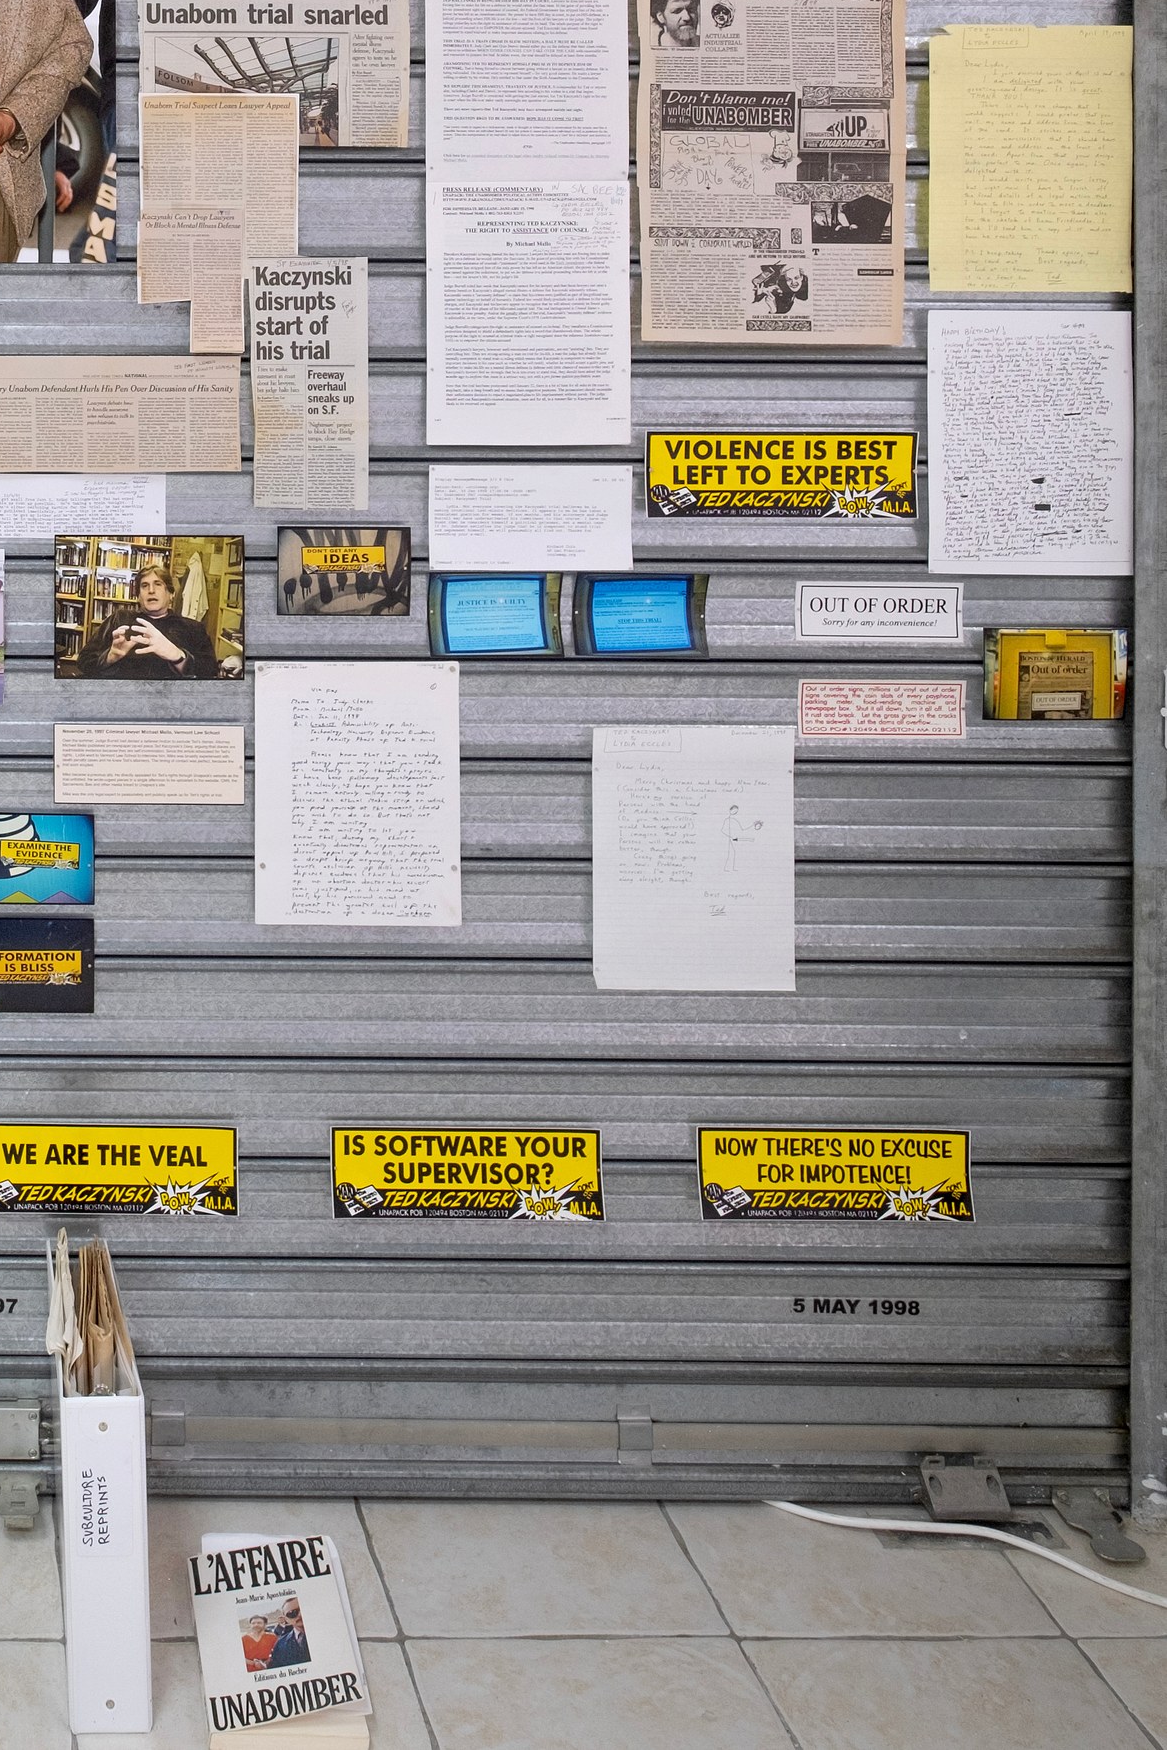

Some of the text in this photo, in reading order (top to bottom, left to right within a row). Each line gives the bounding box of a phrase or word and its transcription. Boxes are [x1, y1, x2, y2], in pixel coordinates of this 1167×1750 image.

[665, 440, 897, 460] VIOLENCE IS BEST
[673, 465, 892, 488] LEFT TO EXPERTS
[810, 598, 947, 613] OUT OF ORDER
[822, 617, 938, 628] Sorry for any inconvenience!
[2, 1144, 207, 1167] WE ARE THE VEAL
[344, 1135, 586, 1157] IS SOFTWARE YOUR
[715, 1138, 952, 1158] NOW THERE'S NO EXCUSE
[384, 1162, 555, 1188] SUPERVISOR?
[758, 1164, 911, 1187] FOR IMPOTENCE!
[793, 1298, 920, 1315] 5 MAY 1998
[97, 1476, 110, 1544] REPRINTS
[190, 1536, 331, 1595] L'AFFAIRE
[209, 1672, 362, 1731] UNABOMBER
